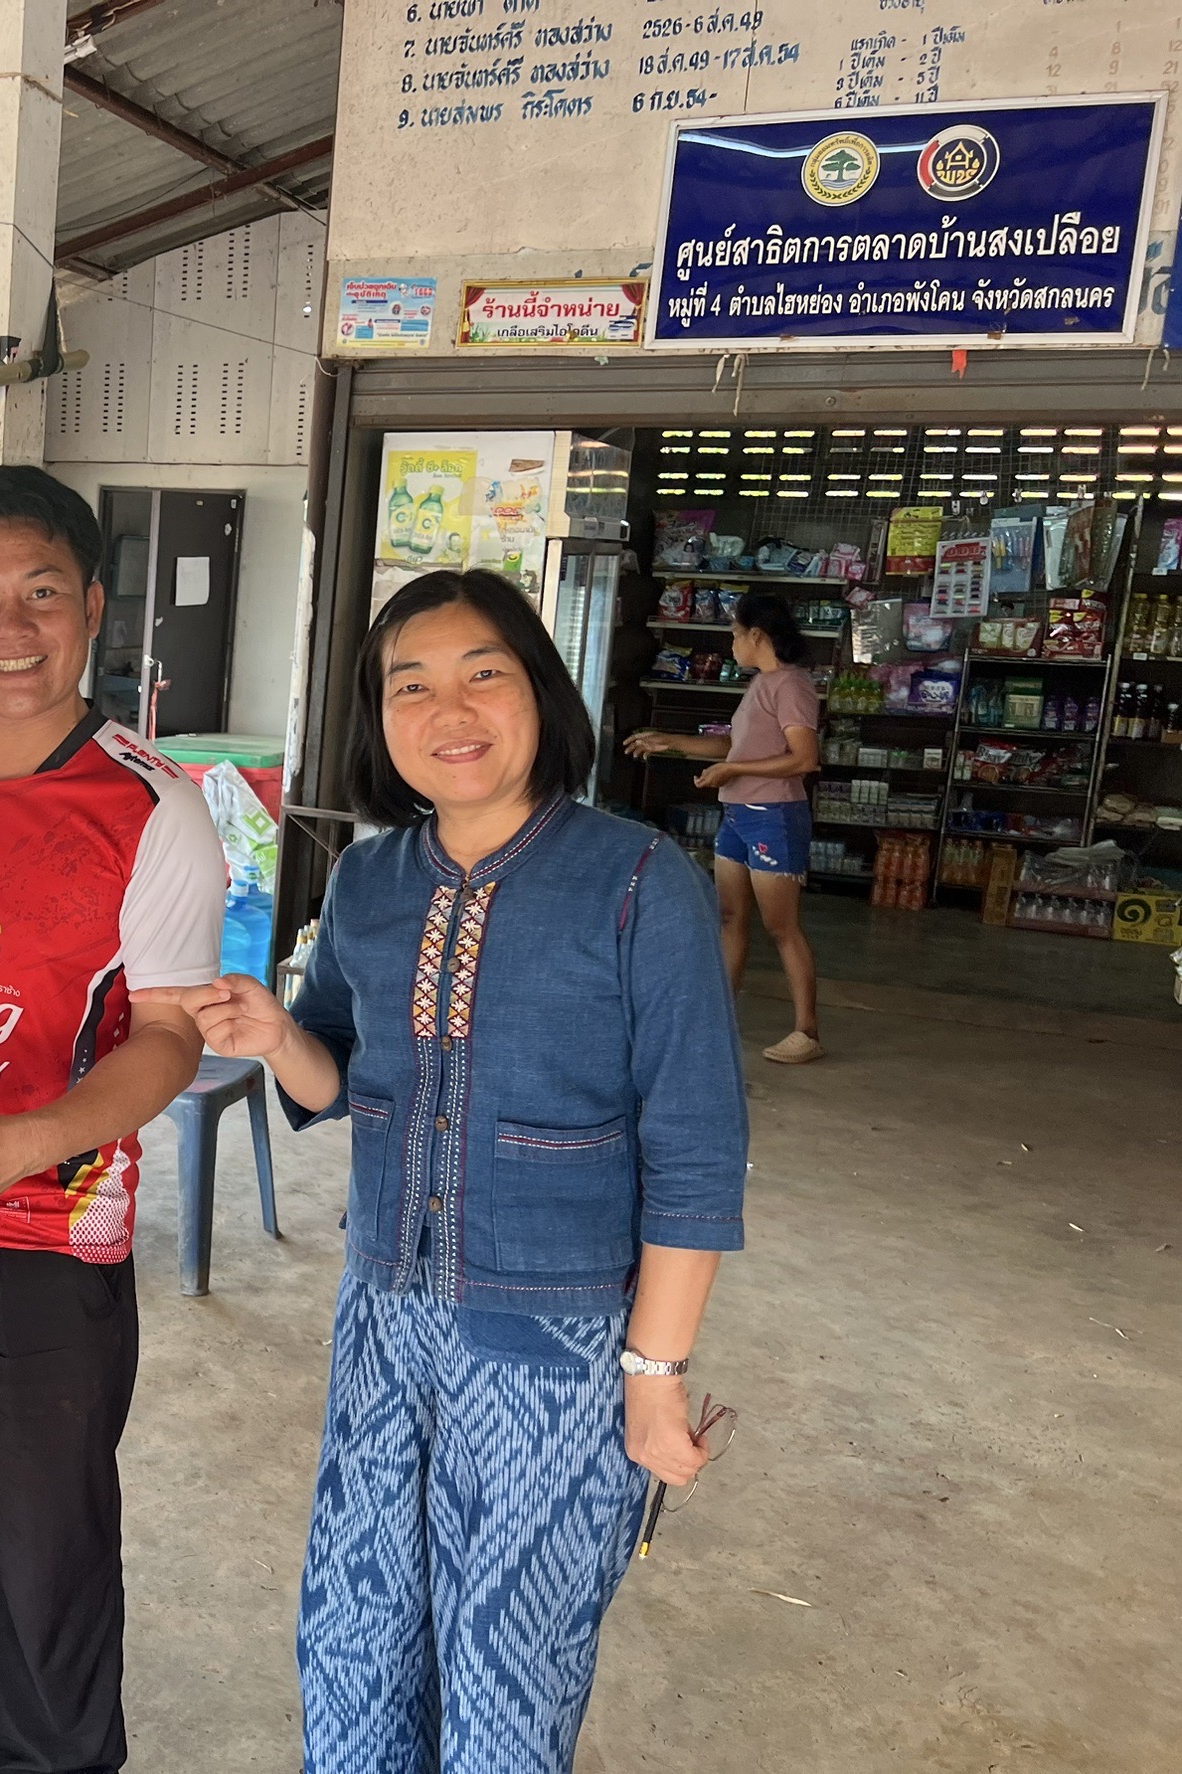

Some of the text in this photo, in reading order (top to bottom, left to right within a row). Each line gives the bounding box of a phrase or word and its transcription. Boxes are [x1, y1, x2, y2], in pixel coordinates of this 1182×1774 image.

[676, 211, 1121, 281] ศูนย์สาธิตการตลาดบ้านสงเปลือย
[482, 290, 621, 319] ร้านนี้จำหน่าย
[668, 281, 708, 328] หมู่ที่
[710, 294, 722, 317] 4
[729, 282, 843, 317] ตำบลไฮหย่อง
[849, 279, 966, 315] อำเภอพังโคน
[971, 277, 1116, 311] จังหวัดสกลนคร
[497, 323, 599, 338] เกลือเสริมไอโอดีน
